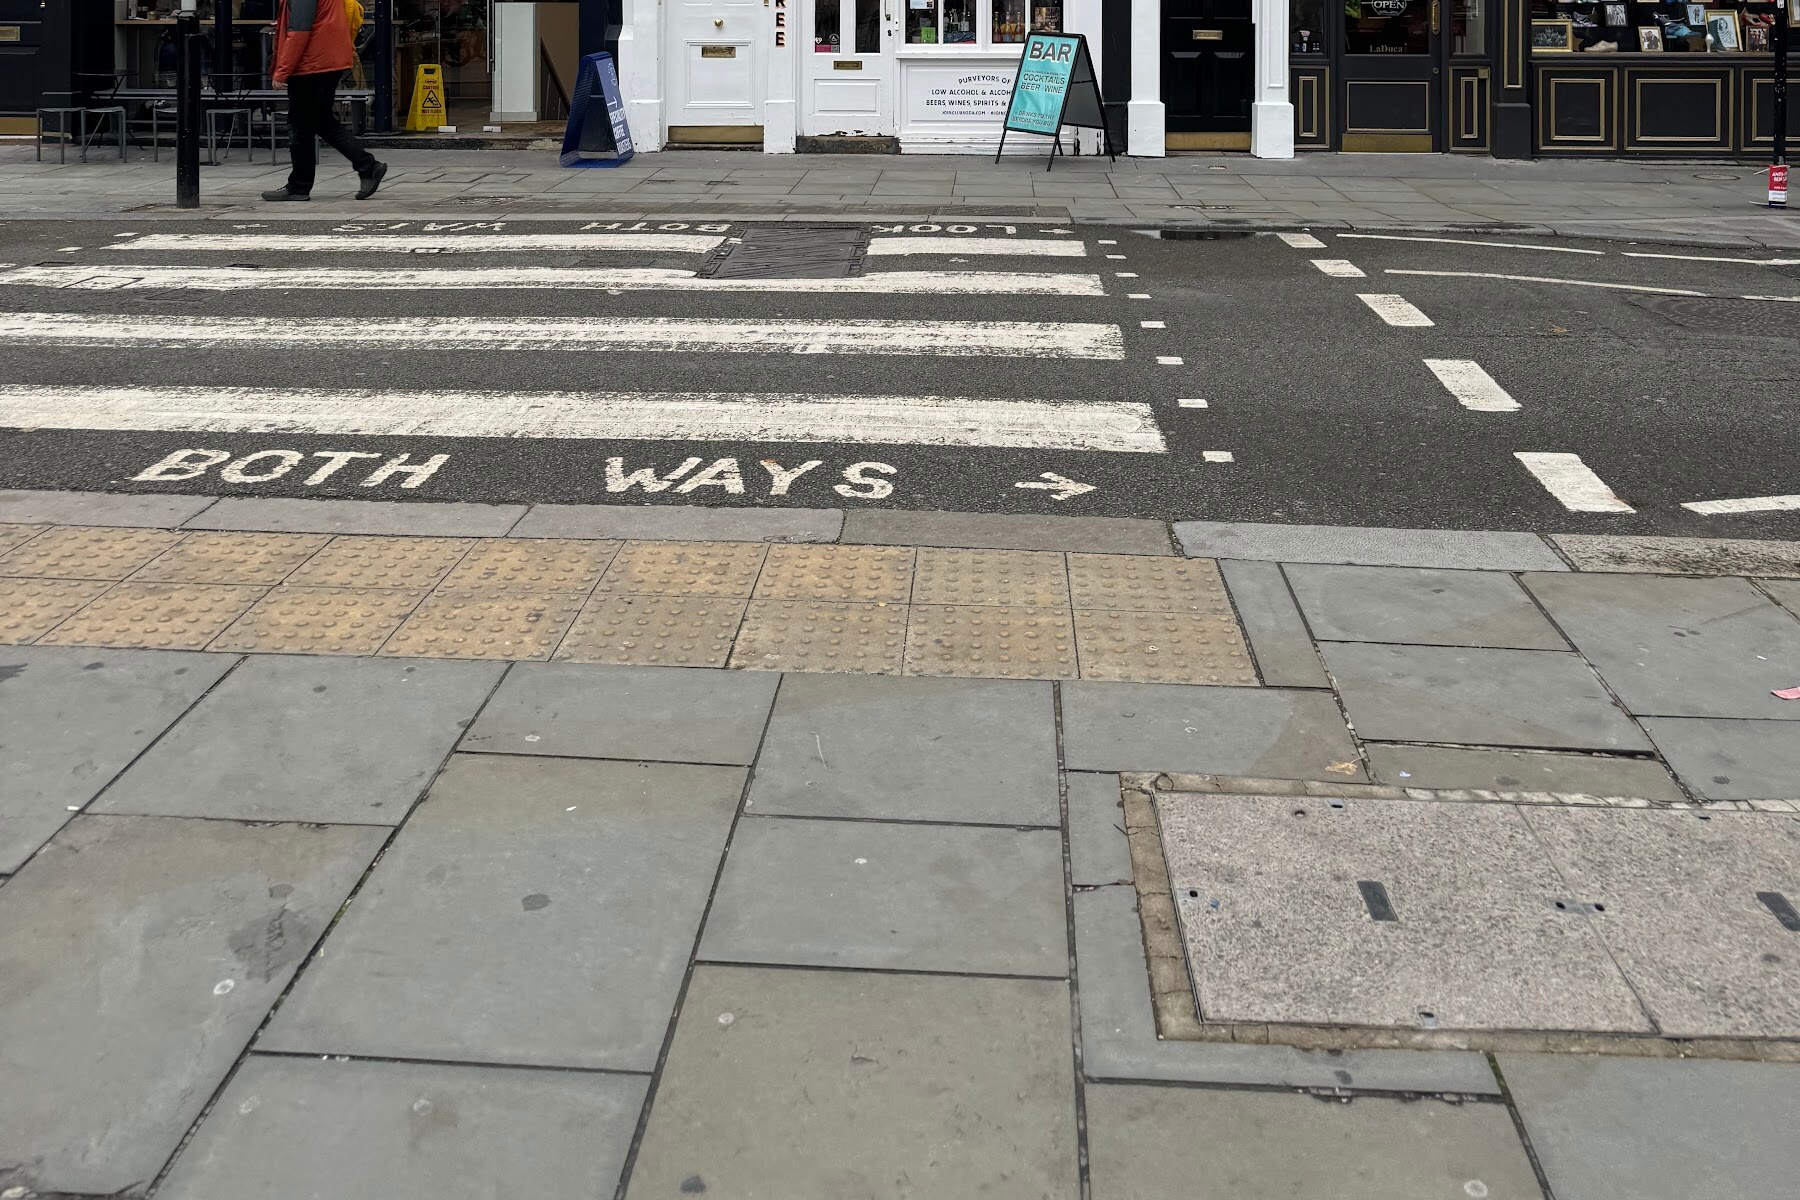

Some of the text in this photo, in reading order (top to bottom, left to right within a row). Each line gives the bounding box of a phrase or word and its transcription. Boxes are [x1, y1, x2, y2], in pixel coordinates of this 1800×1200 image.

[1373, 1, 1405, 9] OPEN
[1028, 40, 1072, 64] BAR
[1369, 44, 1403, 53] LaDuca
[958, 75, 1012, 85] PURVEYORS OF
[1023, 73, 1065, 85] COCKTAILS
[1020, 82, 1063, 94] BEER WINE
[1018, 110, 1037, 118] DRINKS
[333, 220, 1017, 235] LOOK BOTH WAYS
[132, 448, 898, 500] BOTH WAYS
